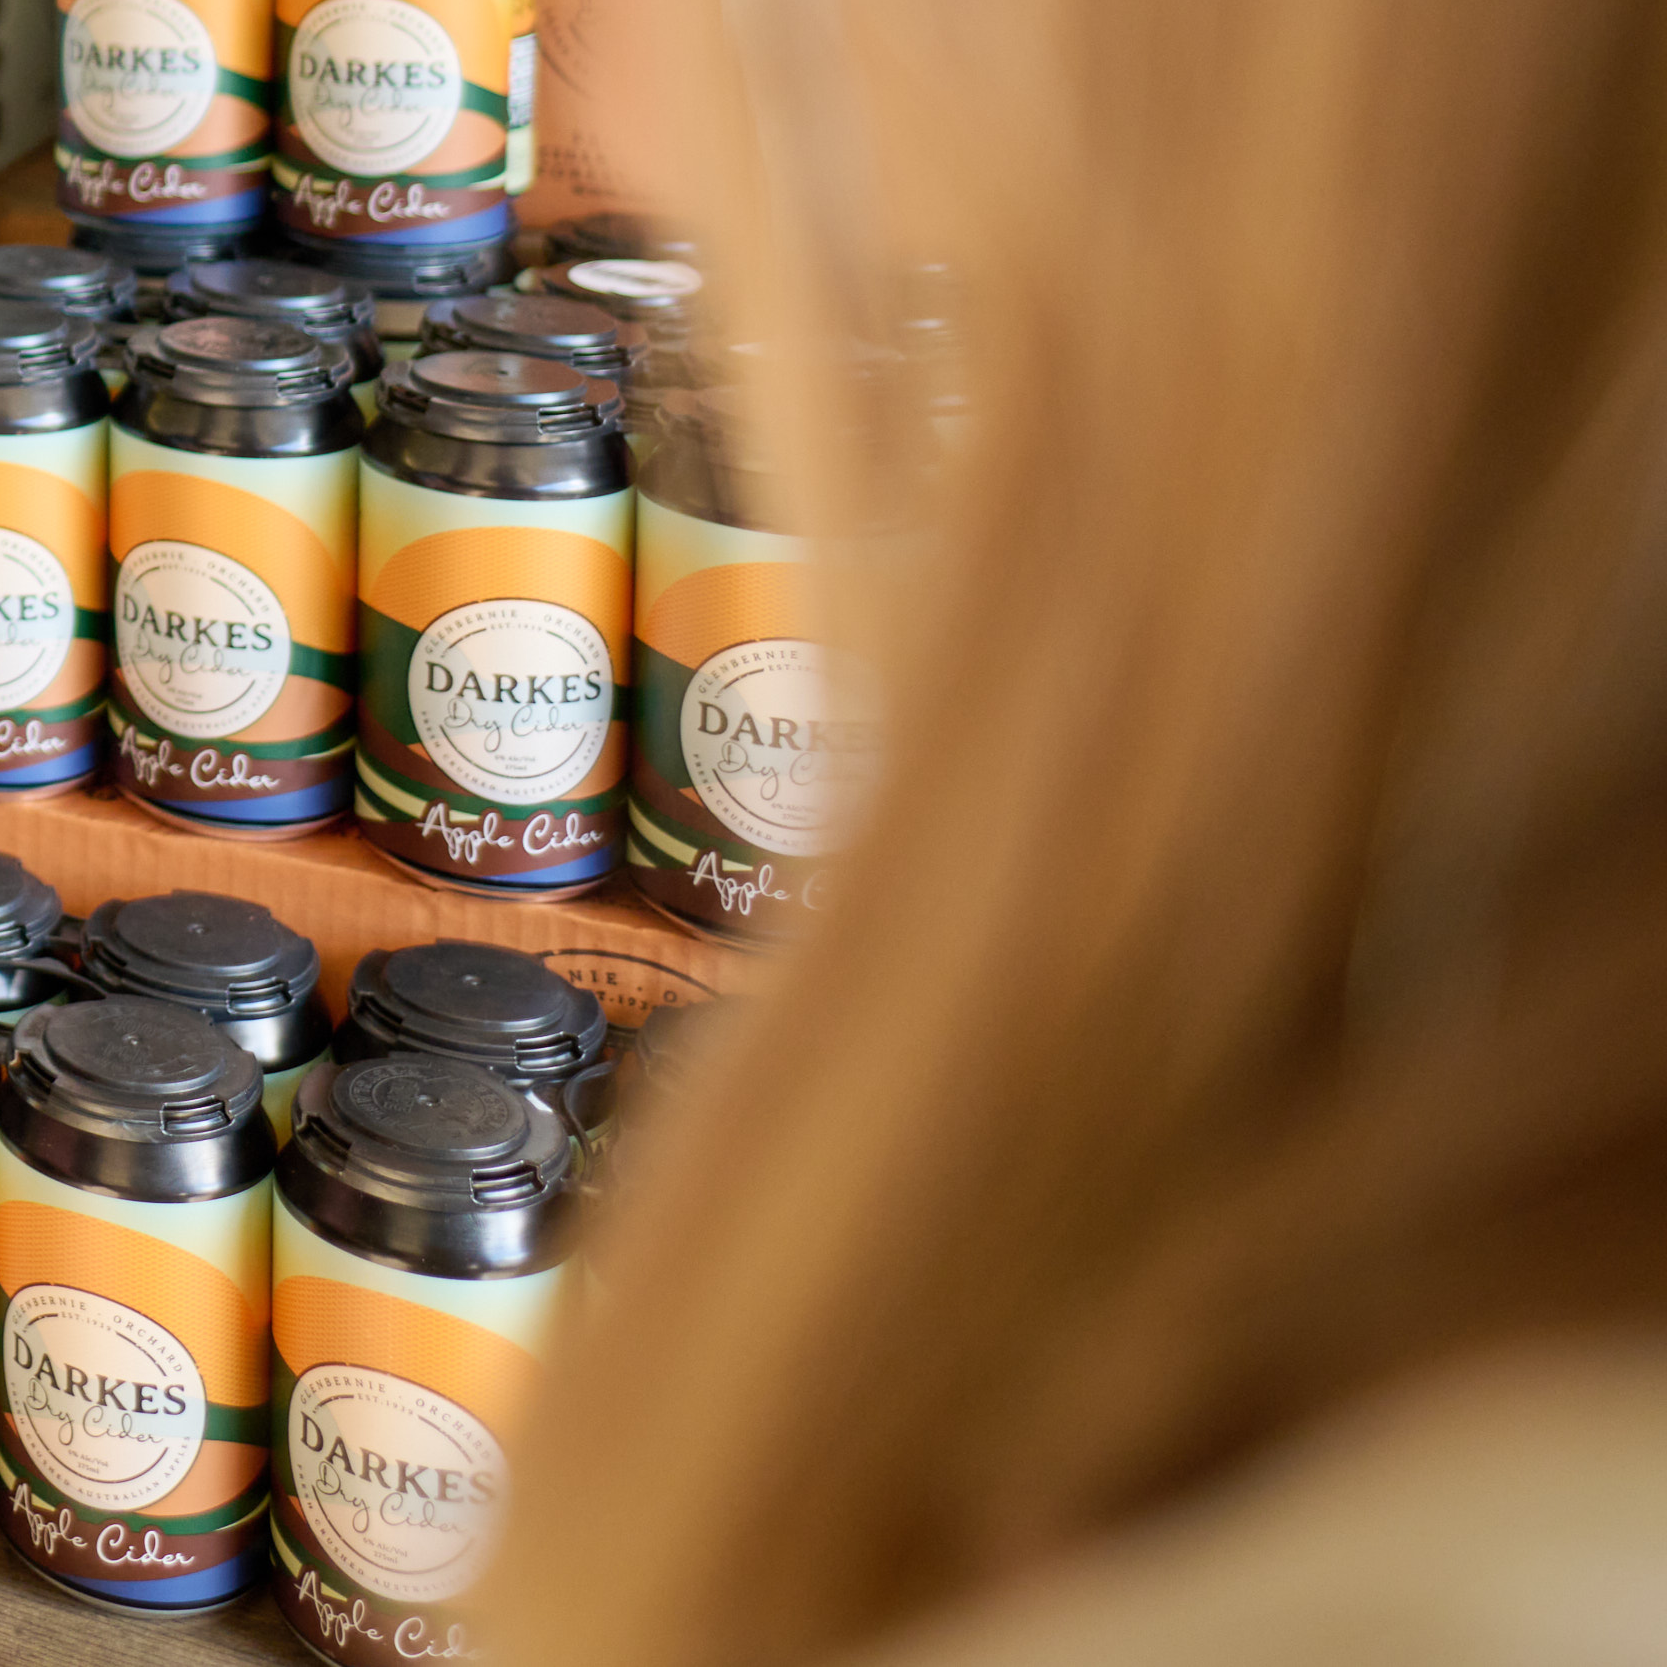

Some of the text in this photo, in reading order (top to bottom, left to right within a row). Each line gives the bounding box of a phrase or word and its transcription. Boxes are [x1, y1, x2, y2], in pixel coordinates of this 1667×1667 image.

[69, 38, 201, 73] DARKES
[299, 52, 446, 88] DARKES
[367, 181, 451, 223] Cider
[122, 592, 273, 651] DARKES
[424, 609, 601, 660] GLENBERNIE ORCHARD
[131, 633, 251, 685] Dry Cider
[425, 661, 602, 705] DARKES
[698, 650, 799, 695] GLENBERNIE
[443, 697, 583, 753] Dry Cider
[696, 700, 830, 752] DARK
[190, 748, 281, 789] Cider
[717, 740, 780, 801] Dry
[416, 802, 604, 864] Apple Cider
[715, 798, 773, 841] CRUSHED
[686, 851, 791, 916] Apple
[112, 1314, 183, 1373] ORCHARD
[13, 1330, 187, 1416] DARKES
[300, 1375, 386, 1405] GLENBERNIE
[27, 1377, 164, 1446] Dry Cider
[300, 1410, 498, 1504] DARKES
[9, 1482, 195, 1566] Apple Cider
[315, 1460, 466, 1534] Dry Cider
[314, 1518, 365, 1576] CRUSHED
[294, 1570, 469, 1659] Apple Cid
